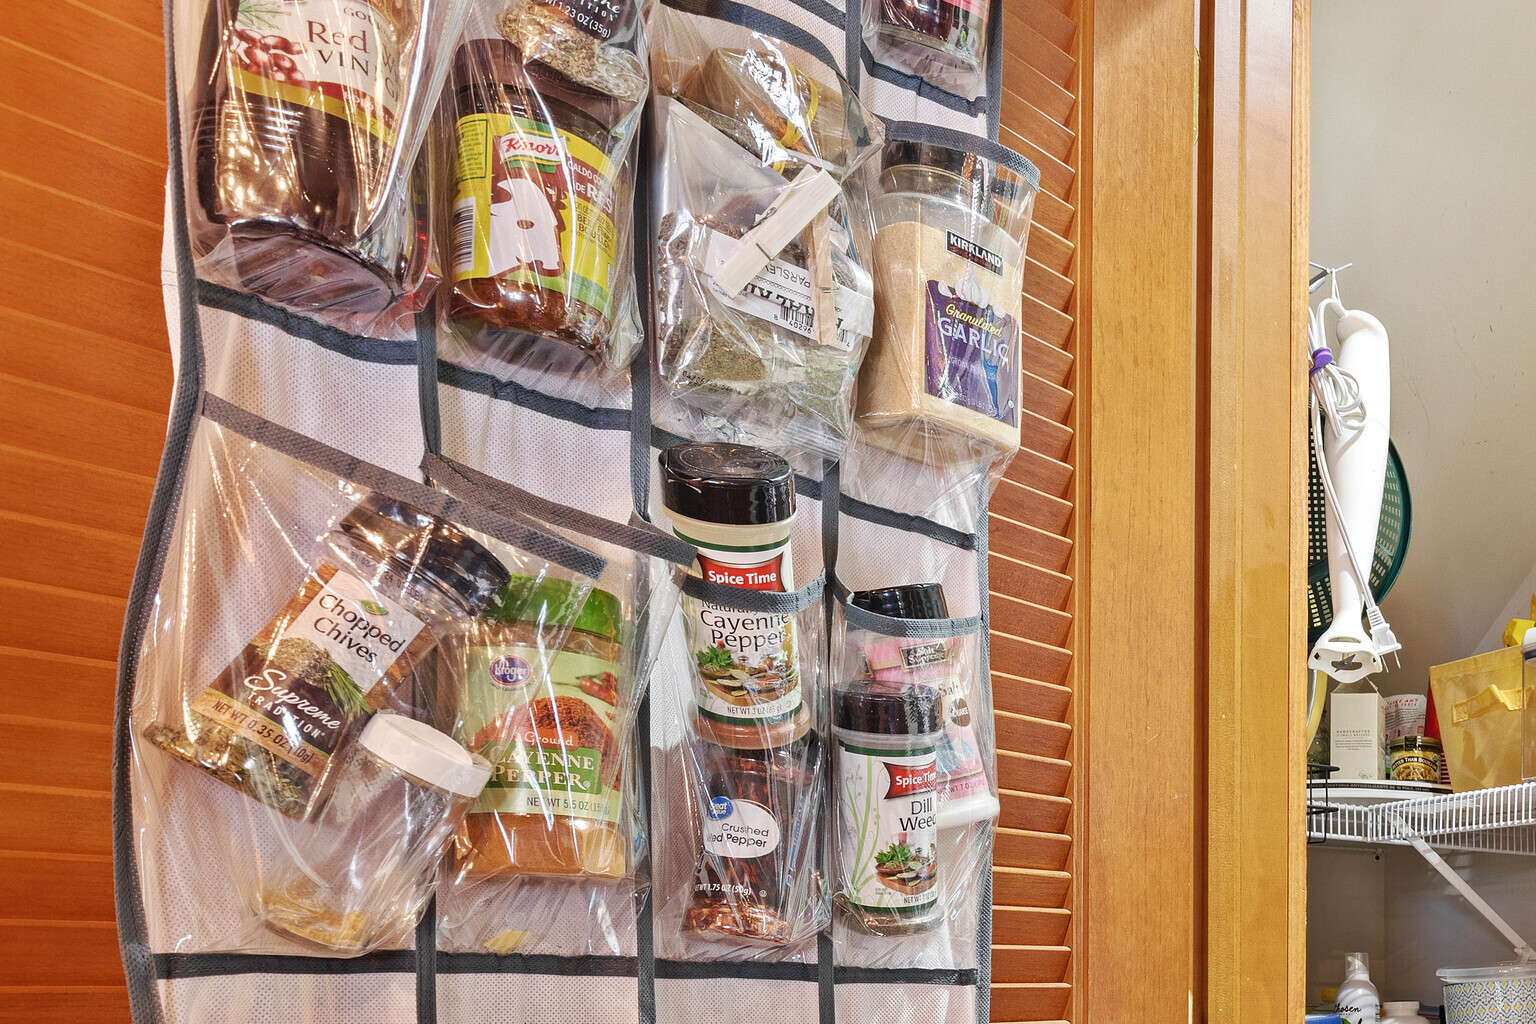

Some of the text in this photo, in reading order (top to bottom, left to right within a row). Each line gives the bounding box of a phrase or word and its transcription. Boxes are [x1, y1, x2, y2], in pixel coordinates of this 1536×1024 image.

[558, 3, 612, 38] 1.23 OZ (35g)
[306, 20, 370, 54] Red
[502, 137, 560, 156] Knorr
[576, 182, 586, 194] DE
[949, 234, 1001, 268] KIRKLAND
[945, 303, 1003, 339] Granulated
[937, 317, 1010, 360] GARLIC
[708, 570, 777, 585] Spice Time
[318, 593, 406, 654] Chopped
[700, 610, 789, 635] Cayenne
[313, 616, 379, 664] Chives
[711, 629, 785, 652] Pepper
[494, 660, 527, 682] Kroger
[244, 669, 341, 730] Supreme
[727, 706, 739, 715] NET
[740, 706, 750, 715] WT
[212, 701, 232, 715] NET
[232, 710, 249, 724] WT
[247, 719, 275, 739] 0.35
[273, 734, 288, 749] OZ
[248, 691, 326, 739] TRADTION
[524, 731, 574, 747] Ground
[896, 771, 936, 788] Spice Tim
[579, 800, 590, 811] OZ
[911, 797, 932, 816] Dill
[721, 822, 770, 837] Crushed
[726, 833, 768, 848] Pepper
[707, 883, 720, 892] 1.75
[731, 885, 752, 897] (50g)
